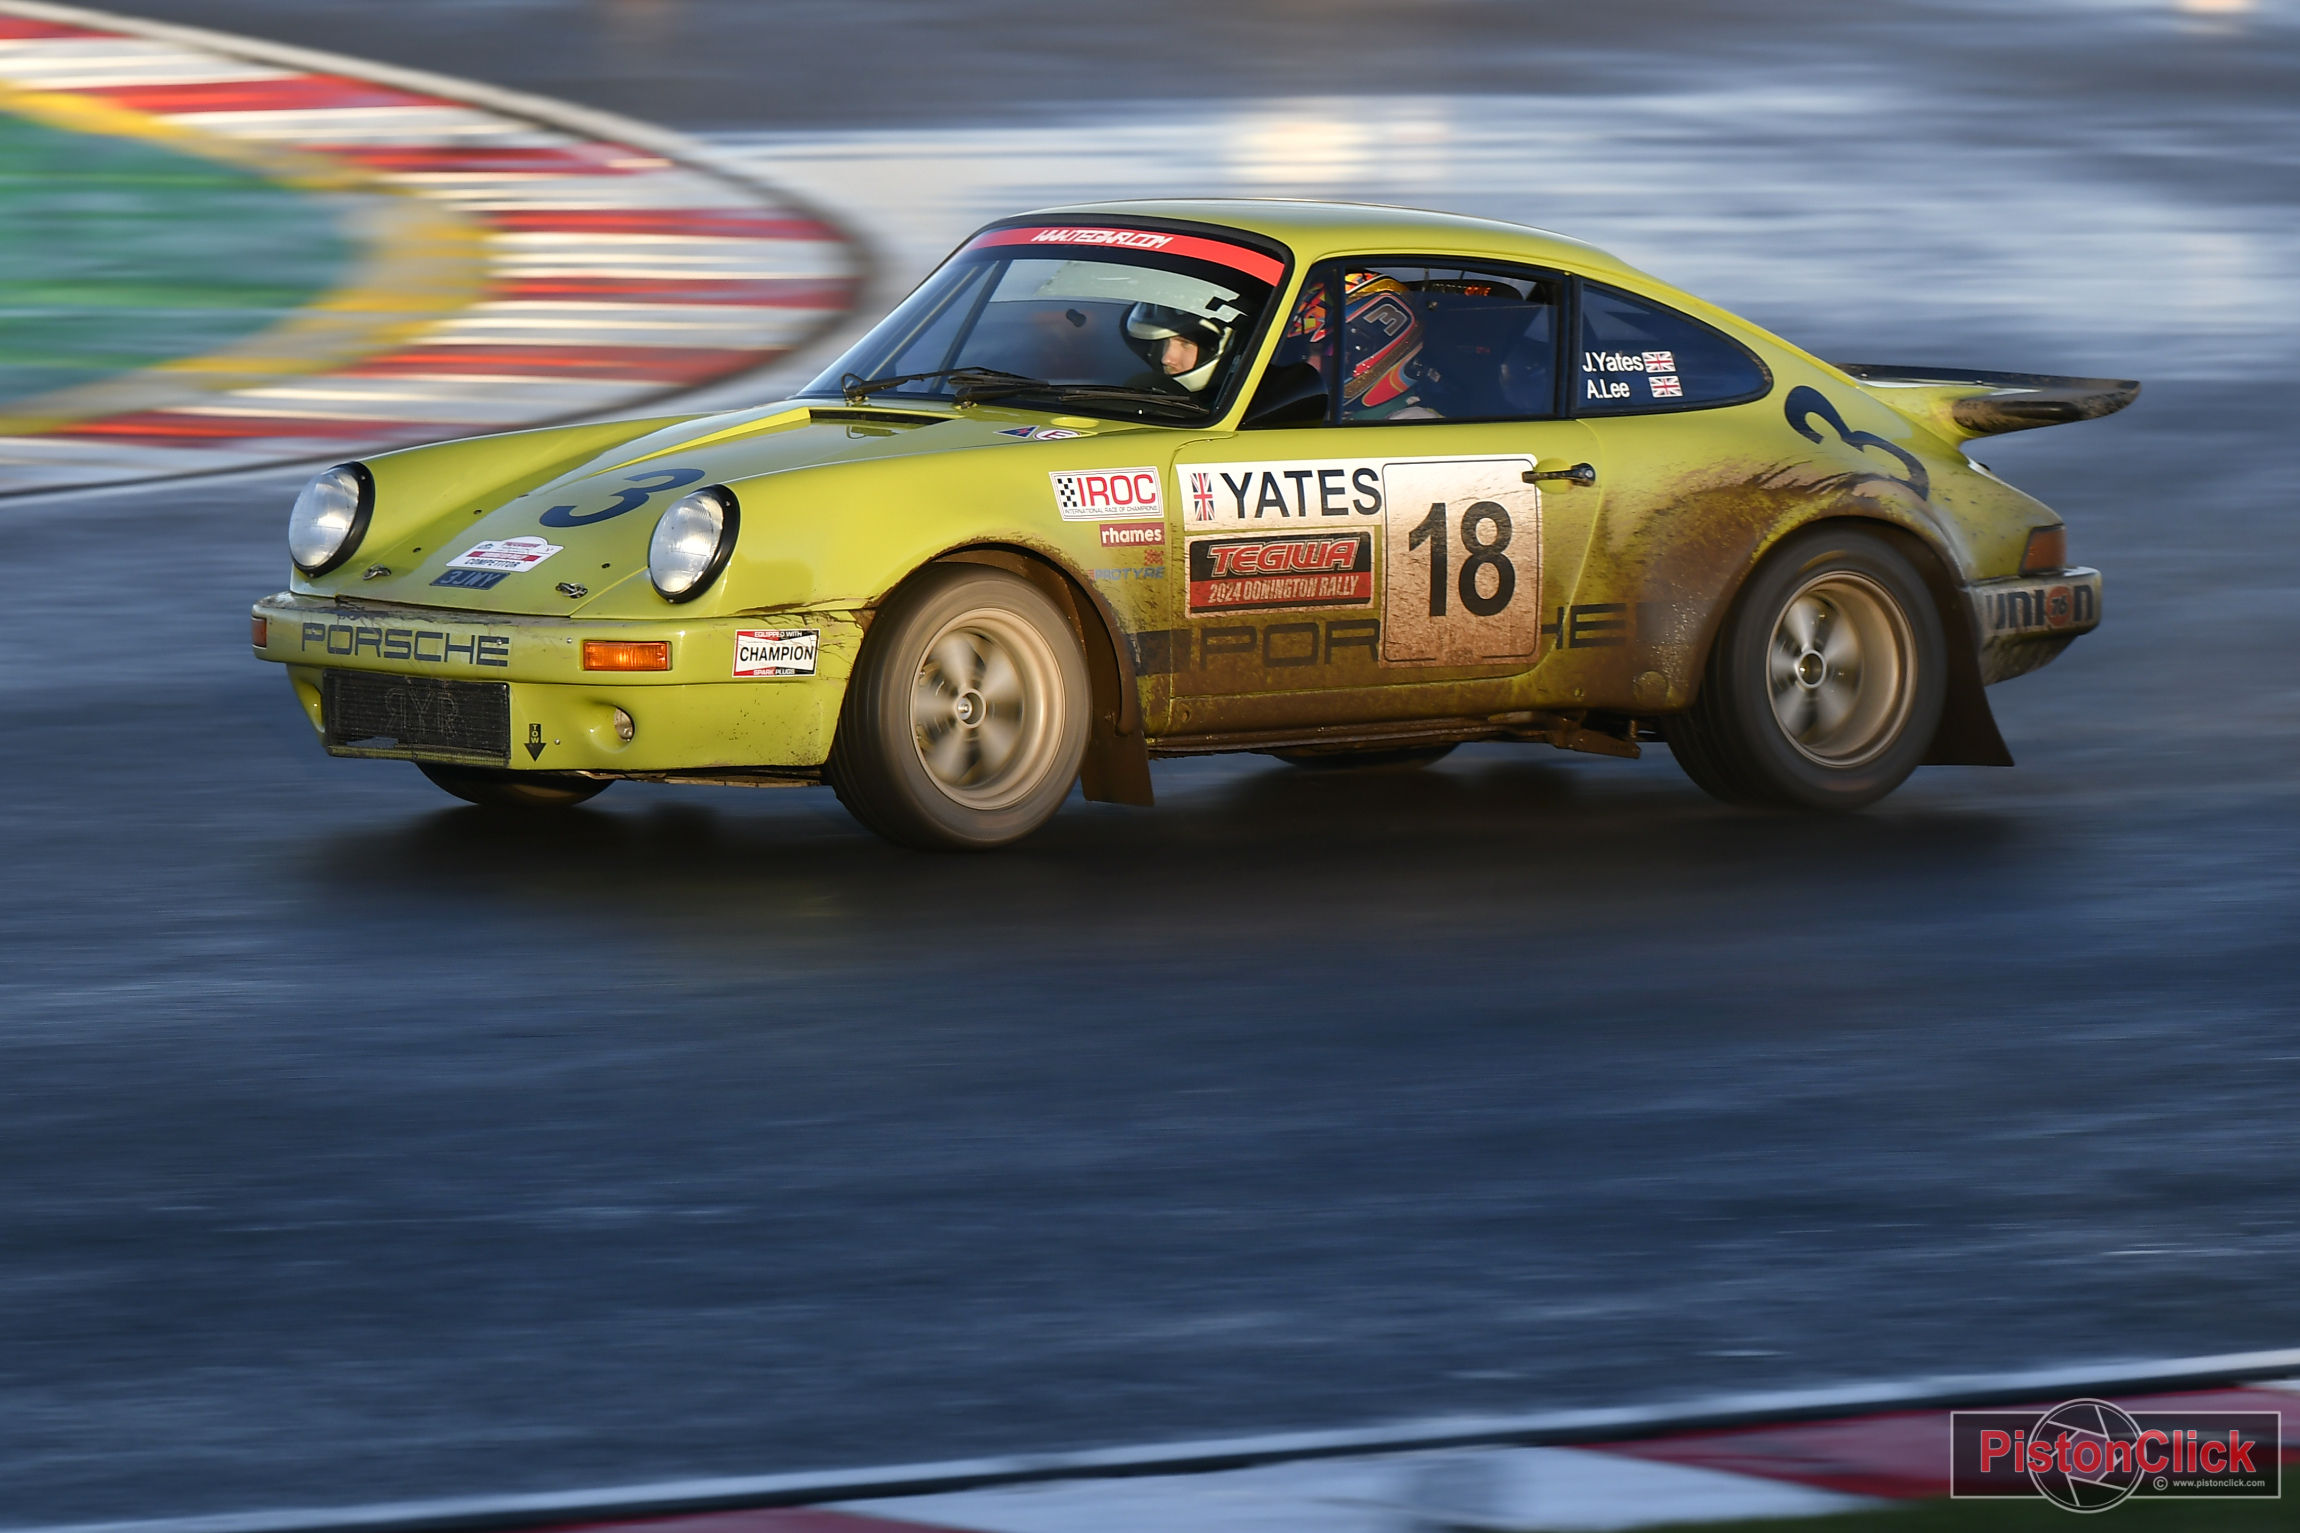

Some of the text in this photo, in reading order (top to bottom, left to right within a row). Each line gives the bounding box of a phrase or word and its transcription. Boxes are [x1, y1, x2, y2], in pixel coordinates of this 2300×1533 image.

[1363, 303, 1408, 337] 3
[1582, 352, 1645, 372] J.Yates
[1587, 379, 1631, 399] A.Lee
[1784, 385, 1929, 501] 3
[539, 468, 706, 528] 3
[1077, 474, 1156, 507] IROC
[1220, 468, 1382, 519] YATES
[1101, 527, 1162, 544] rhames
[1208, 537, 1360, 577] TEGIWA
[1409, 501, 1516, 617] 18
[1094, 566, 1165, 580] PROTYRE
[1208, 575, 1359, 604] 2024 DONINGTON RALLY
[301, 622, 510, 667] PORSCHE
[740, 645, 815, 662] CHAMPION
[753, 668, 796, 676] SPARK PLUGS
[531, 724, 540, 744] TOW
